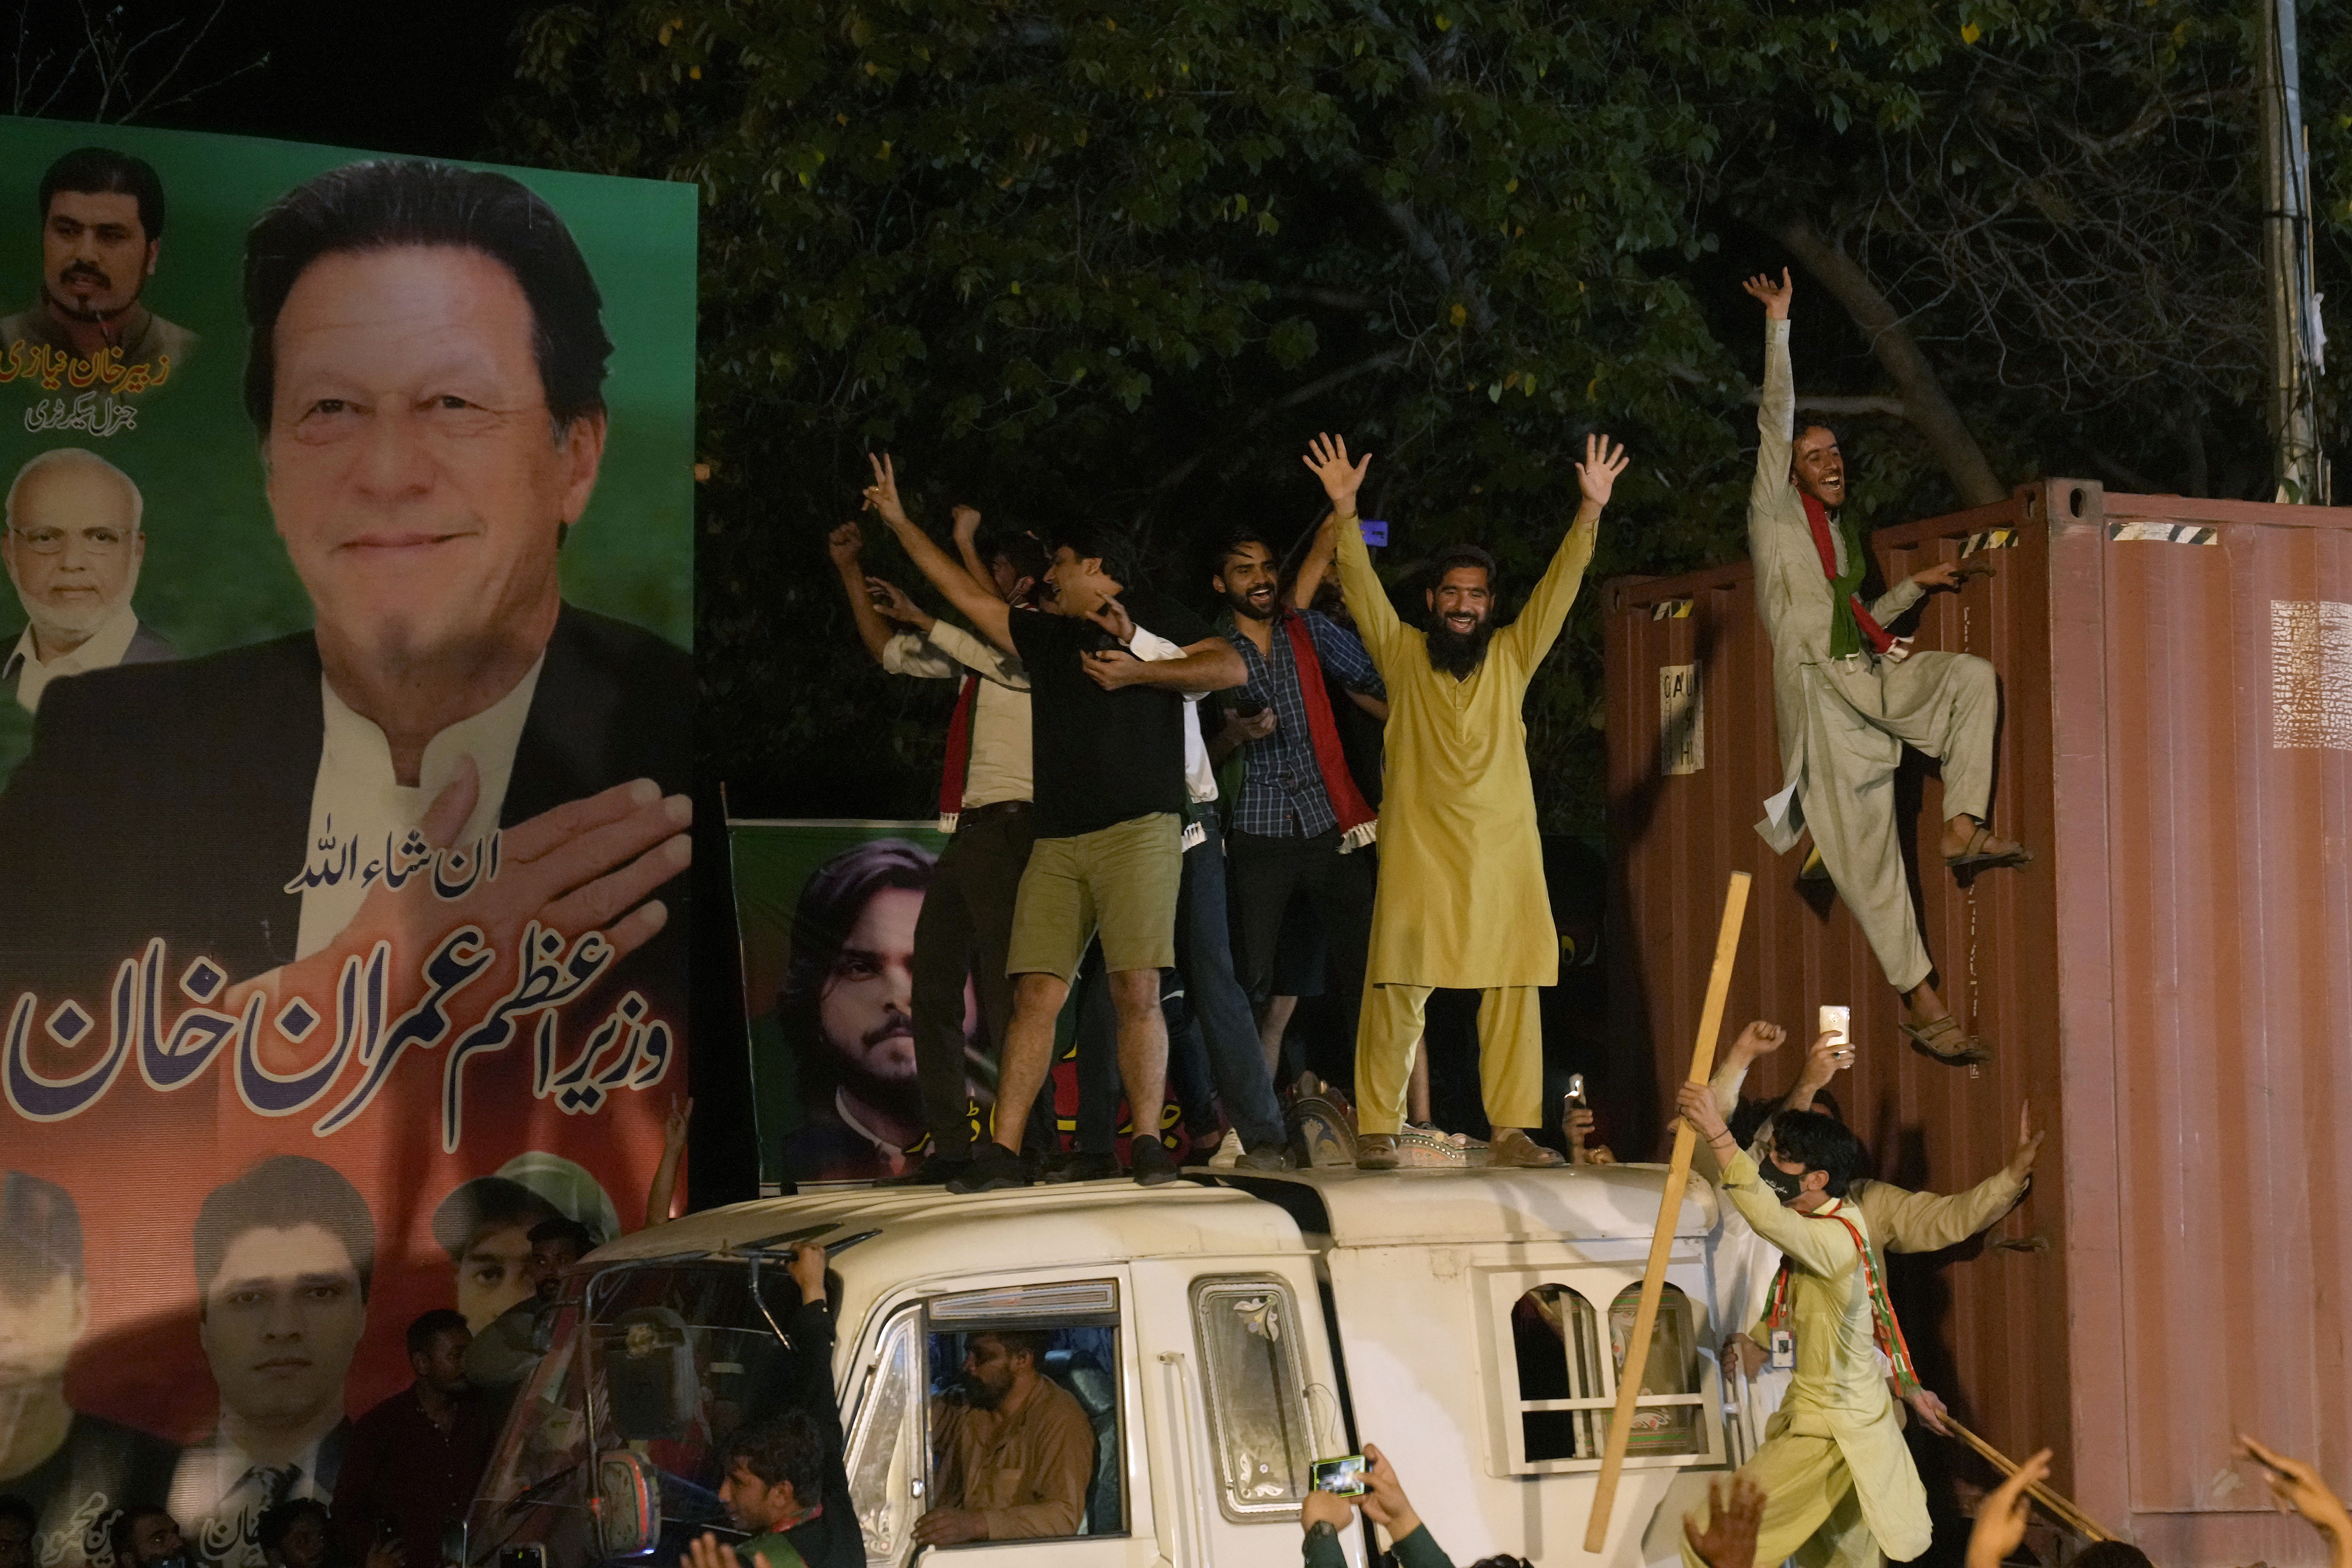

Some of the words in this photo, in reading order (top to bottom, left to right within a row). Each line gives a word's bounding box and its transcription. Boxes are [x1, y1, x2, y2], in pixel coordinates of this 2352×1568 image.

[0, 339, 67, 390] نیازی
[68, 347, 127, 387] خان
[112, 354, 170, 393] زبیر
[88, 397, 137, 437] جنرل
[1, 937, 242, 1123] خان
[234, 925, 496, 1138] عمران
